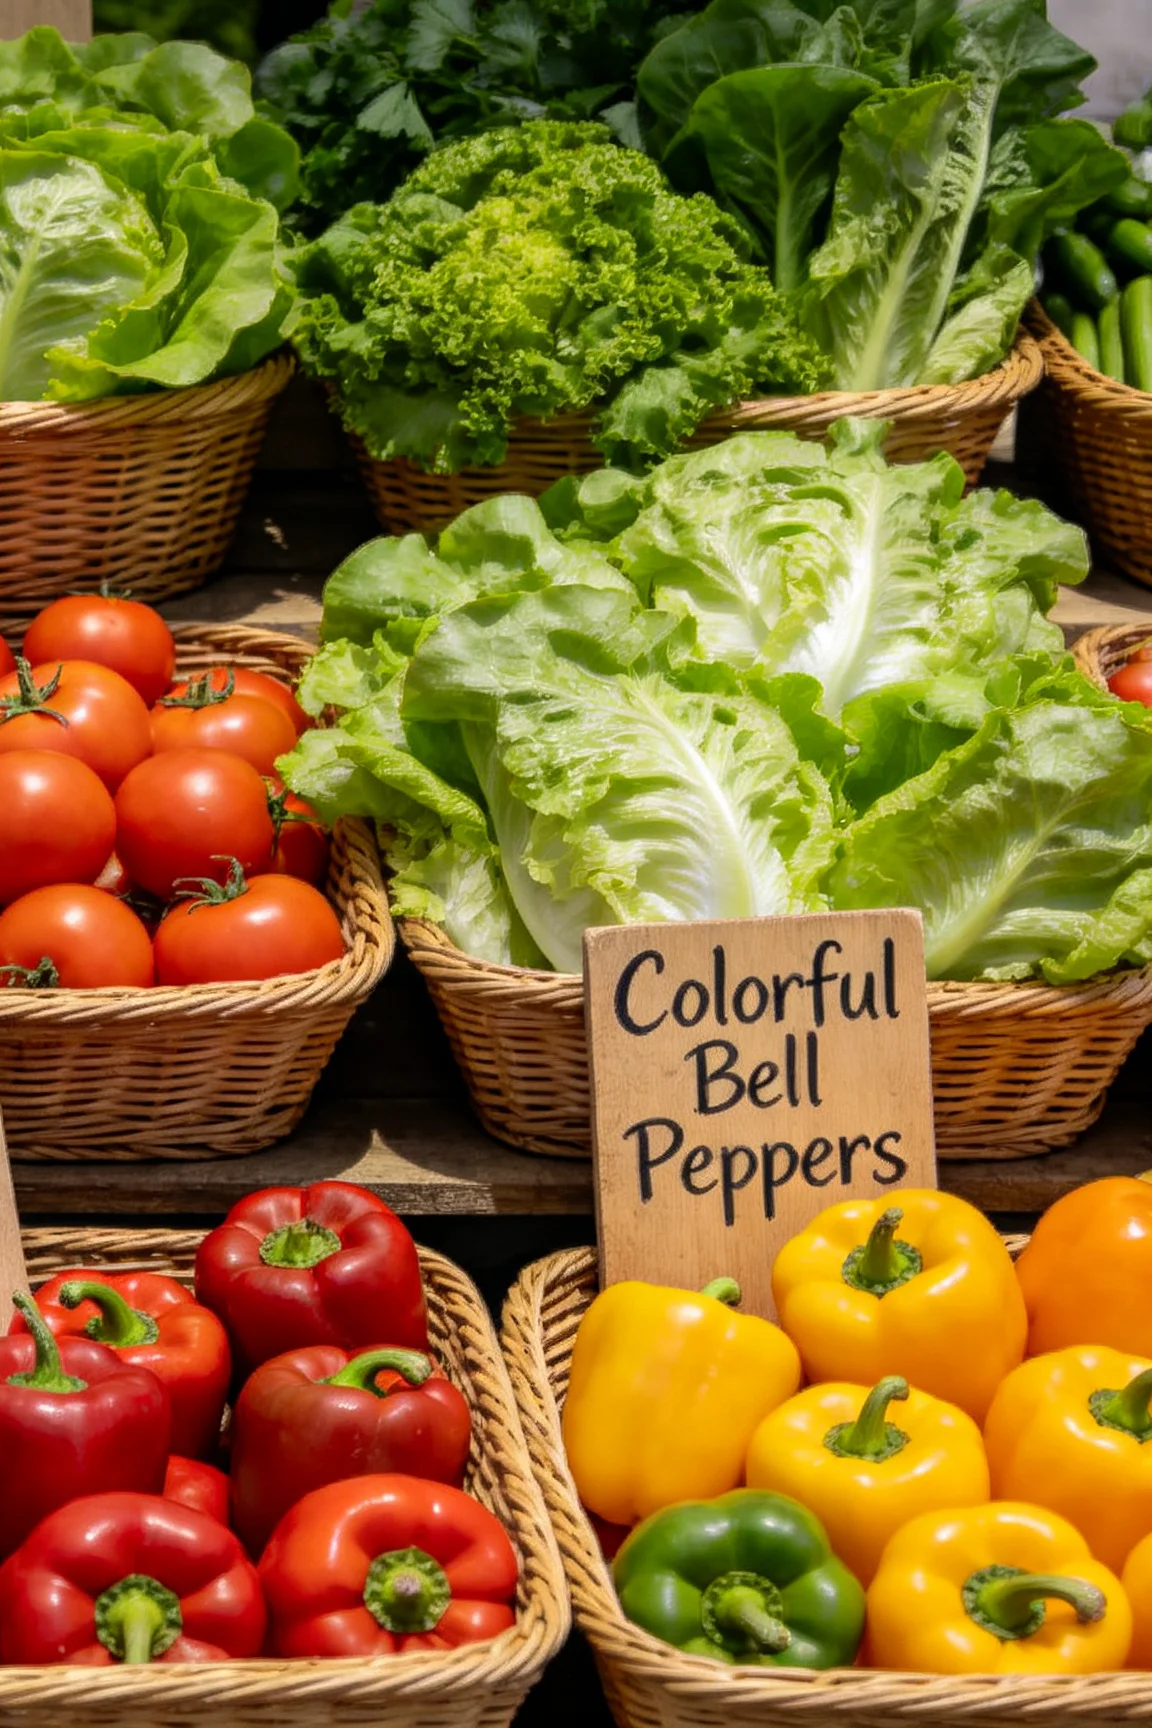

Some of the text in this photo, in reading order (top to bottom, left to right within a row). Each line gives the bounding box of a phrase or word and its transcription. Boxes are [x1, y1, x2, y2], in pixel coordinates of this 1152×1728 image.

[613, 937, 901, 1037] Colorful
[684, 1030, 823, 1115] Bell
[622, 1118, 908, 1228] Peppers
